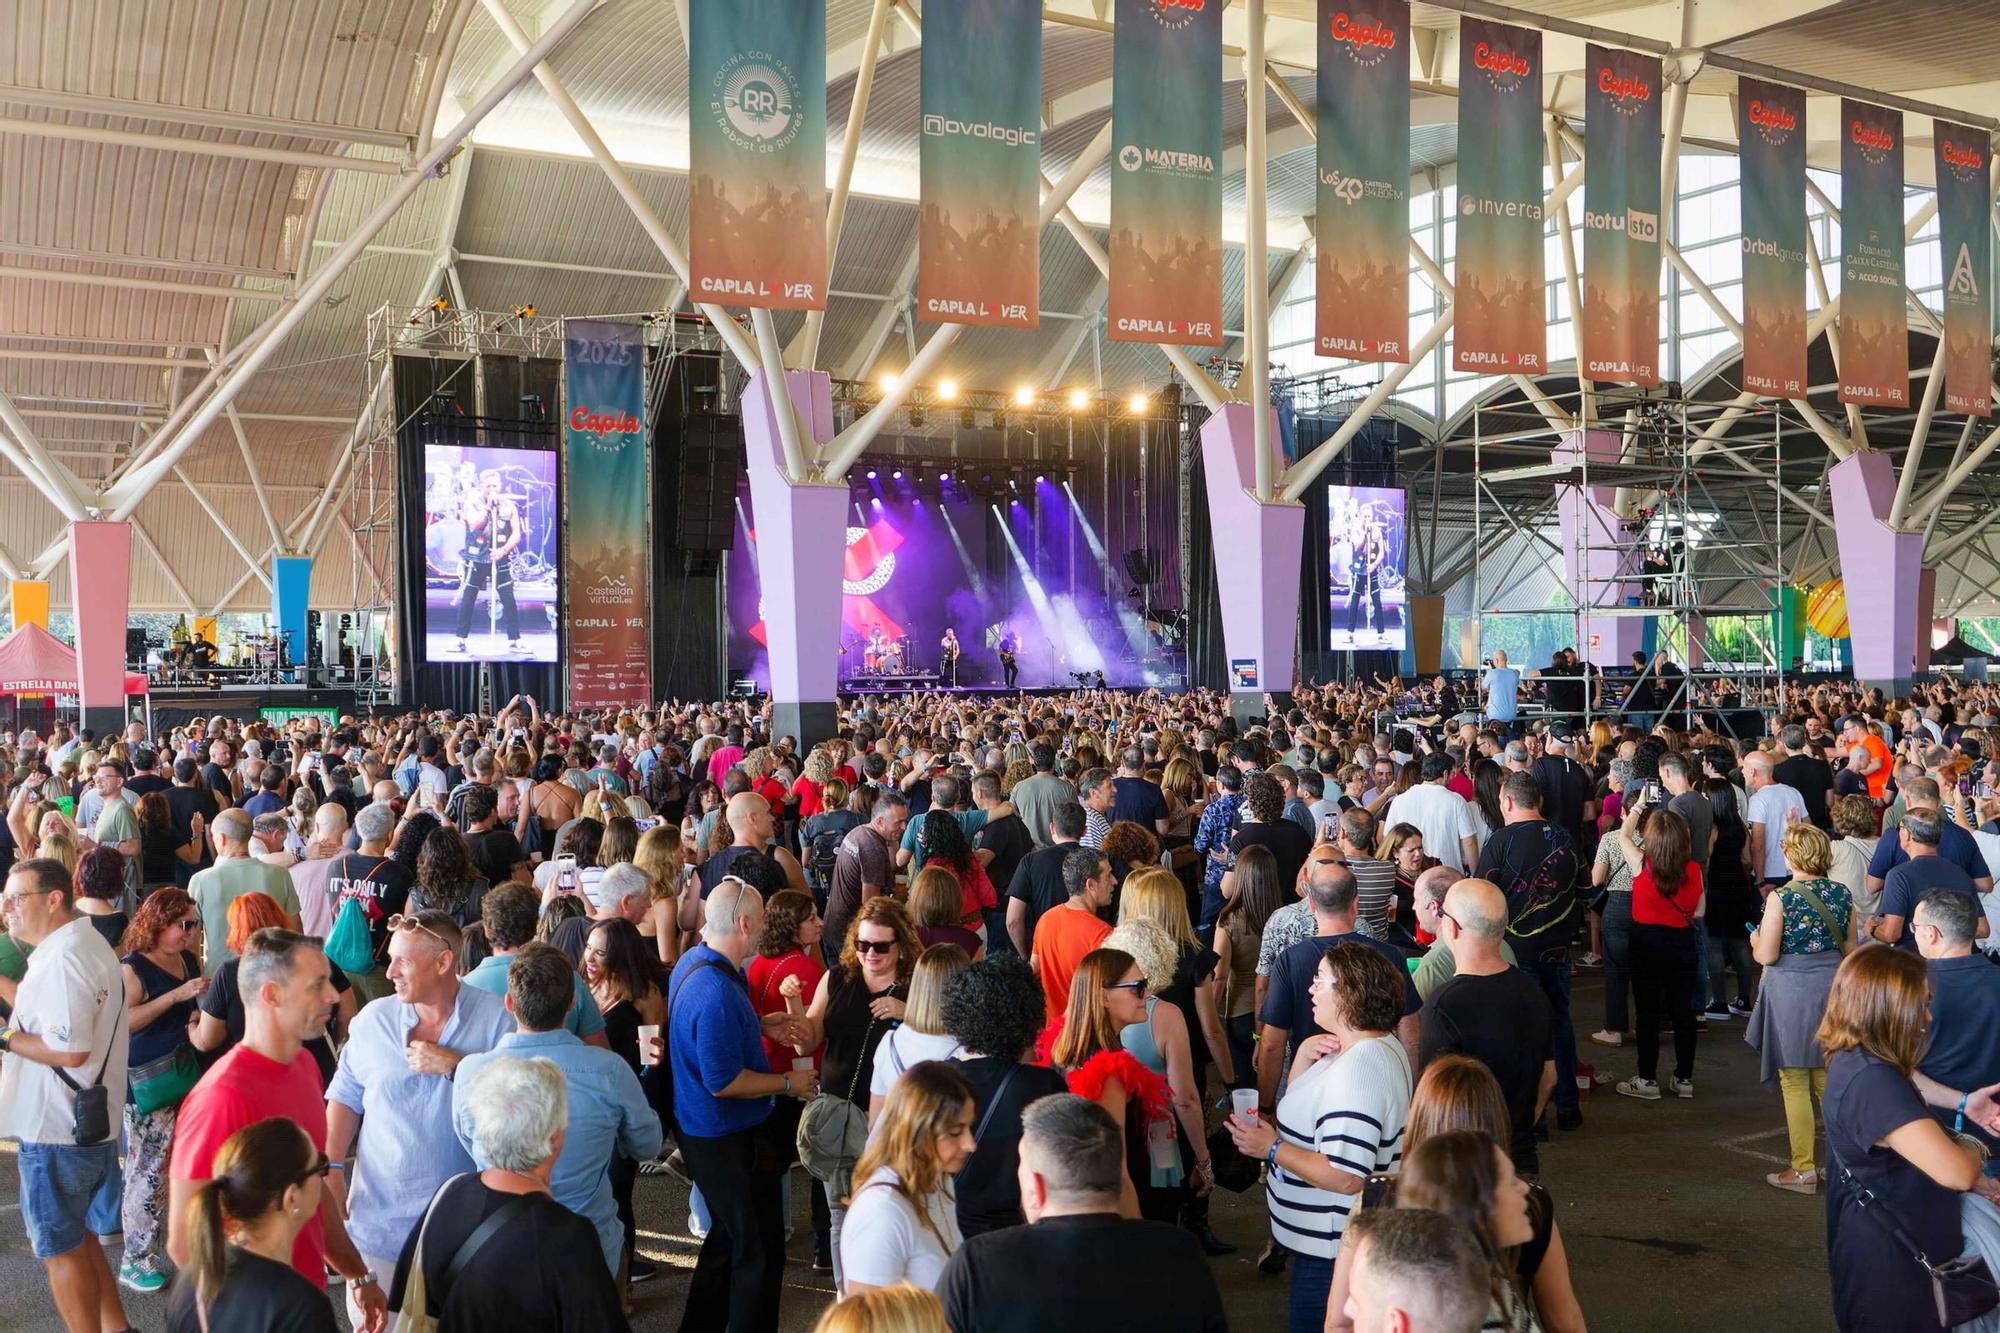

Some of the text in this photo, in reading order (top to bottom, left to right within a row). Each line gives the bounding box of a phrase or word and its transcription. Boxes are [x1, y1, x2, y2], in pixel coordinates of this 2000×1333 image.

[1331, 12, 1396, 51] Capla
[713, 53, 745, 87] COCINA
[748, 50, 772, 61] CON
[1474, 42, 1530, 78] Capla
[1599, 68, 1650, 102] Capla
[744, 89, 774, 113] RR
[1749, 99, 1796, 131] Capla
[759, 144, 774, 153] de
[776, 112, 803, 150] Roures
[923, 114, 1036, 146] novologic
[1852, 119, 1894, 151] Capla
[1145, 148, 1214, 171] MATERIA
[1335, 177, 1363, 205] 40
[1479, 199, 1542, 220] inverca
[700, 277, 756, 296] CAPLA
[928, 298, 976, 316] CAPLA
[1118, 318, 1165, 333] CAPLA
[577, 338, 633, 366] 2025
[1321, 336, 1358, 352] CAPLA
[1460, 351, 1499, 364] CAPLA
[1589, 361, 1630, 373] CAPLA
[1746, 375, 1772, 389] CAPLA
[1844, 385, 1874, 398] CAPLA
[570, 406, 641, 437] Capla
[575, 618, 609, 628] CAPLA
[3, 680, 80, 690] ESTRELLA DAM
[329, 877, 388, 899] IT'S ONLY
